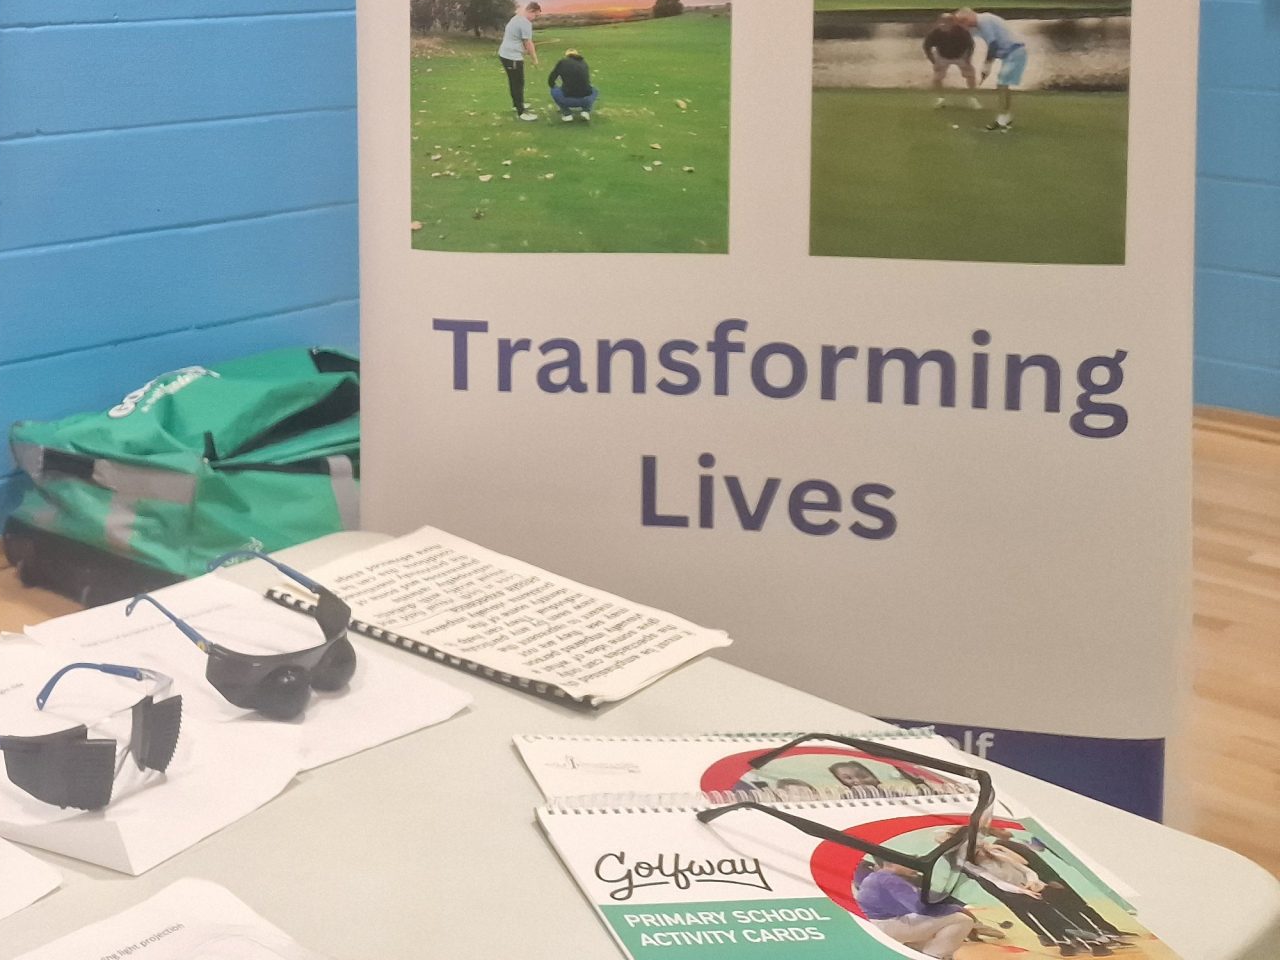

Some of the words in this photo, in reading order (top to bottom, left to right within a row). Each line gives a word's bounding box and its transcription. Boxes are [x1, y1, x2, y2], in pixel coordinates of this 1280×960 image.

[432, 318, 1129, 440] Transforming
[640, 452, 898, 540] Lives
[595, 851, 773, 901] Golfway
[140, 923, 185, 948] projection
[623, 911, 726, 928] PRIMARY
[732, 907, 832, 924] SCHOOL
[642, 929, 740, 947] ACTIVITY
[742, 926, 826, 944] CARDS
